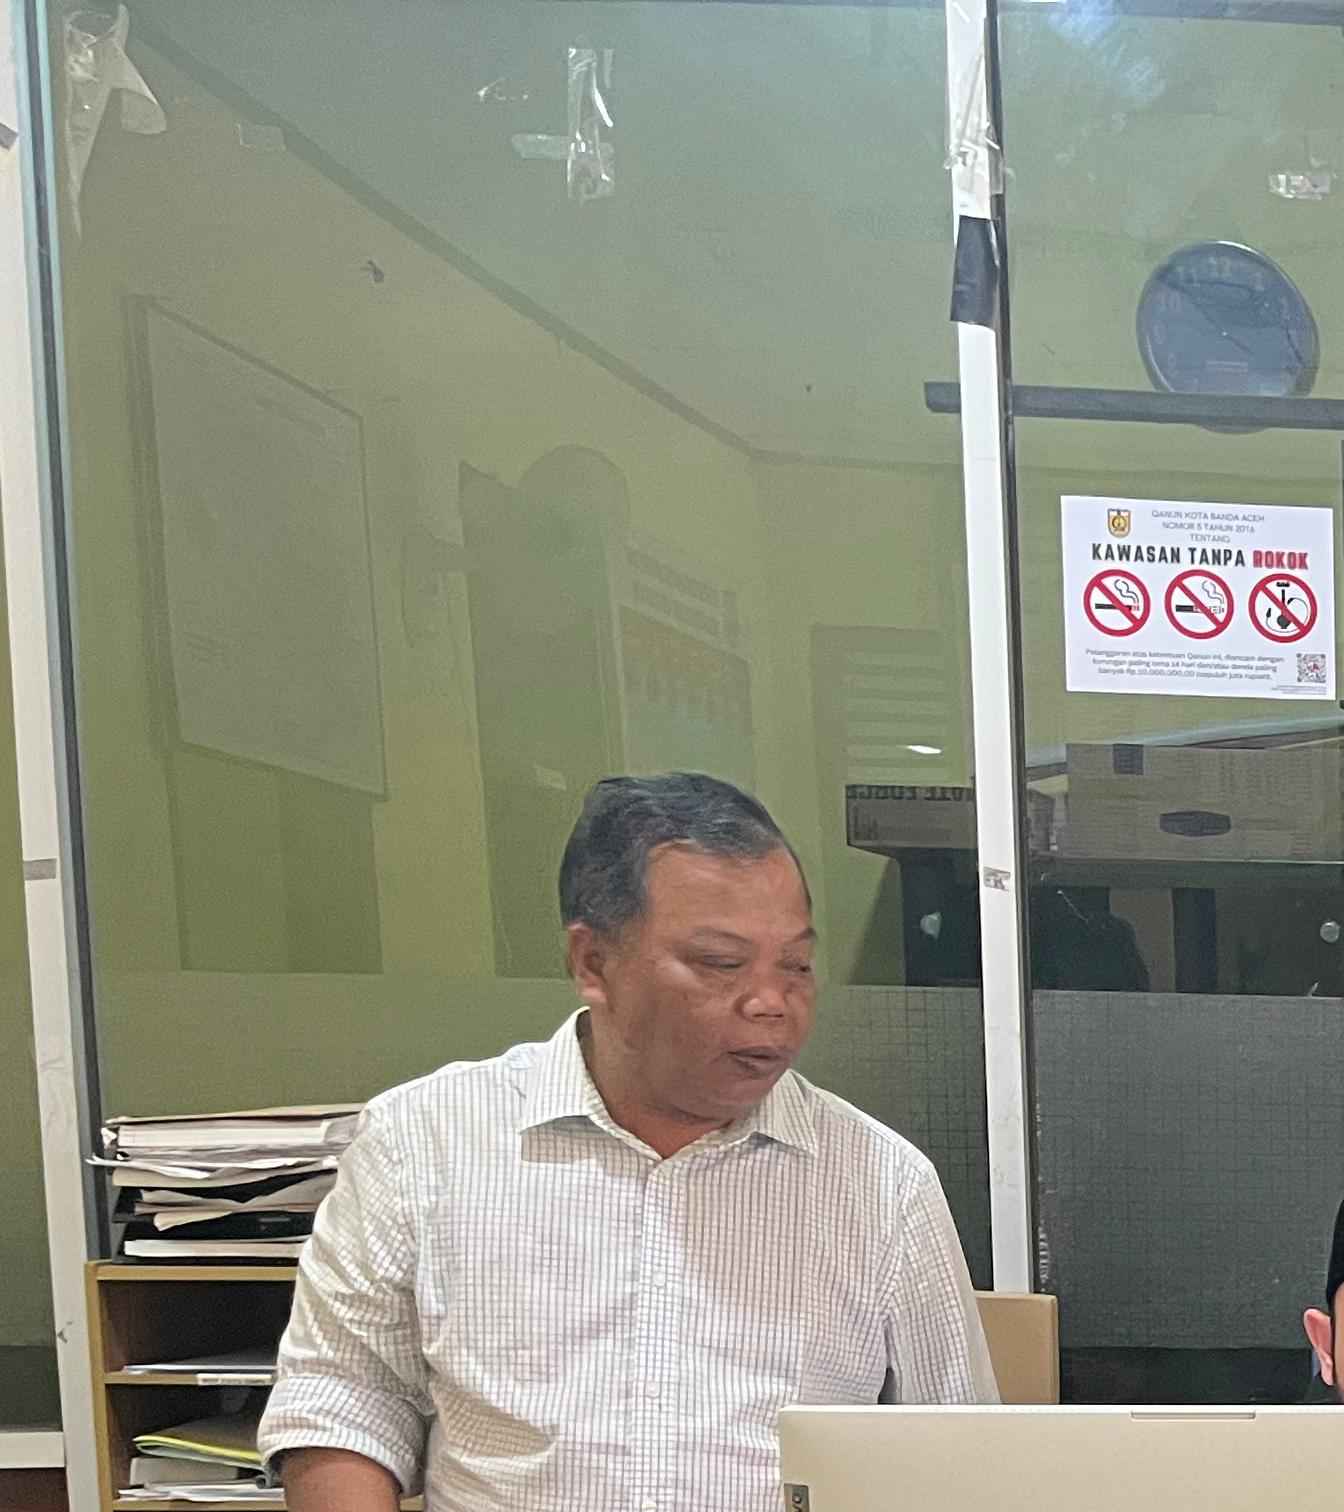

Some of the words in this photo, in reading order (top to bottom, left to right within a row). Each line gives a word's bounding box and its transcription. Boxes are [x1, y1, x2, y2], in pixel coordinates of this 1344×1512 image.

[1151, 509, 1183, 520] QANUN
[1184, 511, 1209, 521] KOTA
[1210, 512, 1240, 521] BANDA
[1241, 513, 1265, 522] ACEH
[1162, 521, 1195, 531] NOMOR
[1204, 523, 1234, 532] TAHUN
[1190, 533, 1231, 543] TENTANG
[1091, 543, 1181, 564] KAWASAN
[1188, 547, 1246, 567] TANPA
[1252, 550, 1309, 570] ROKOK
